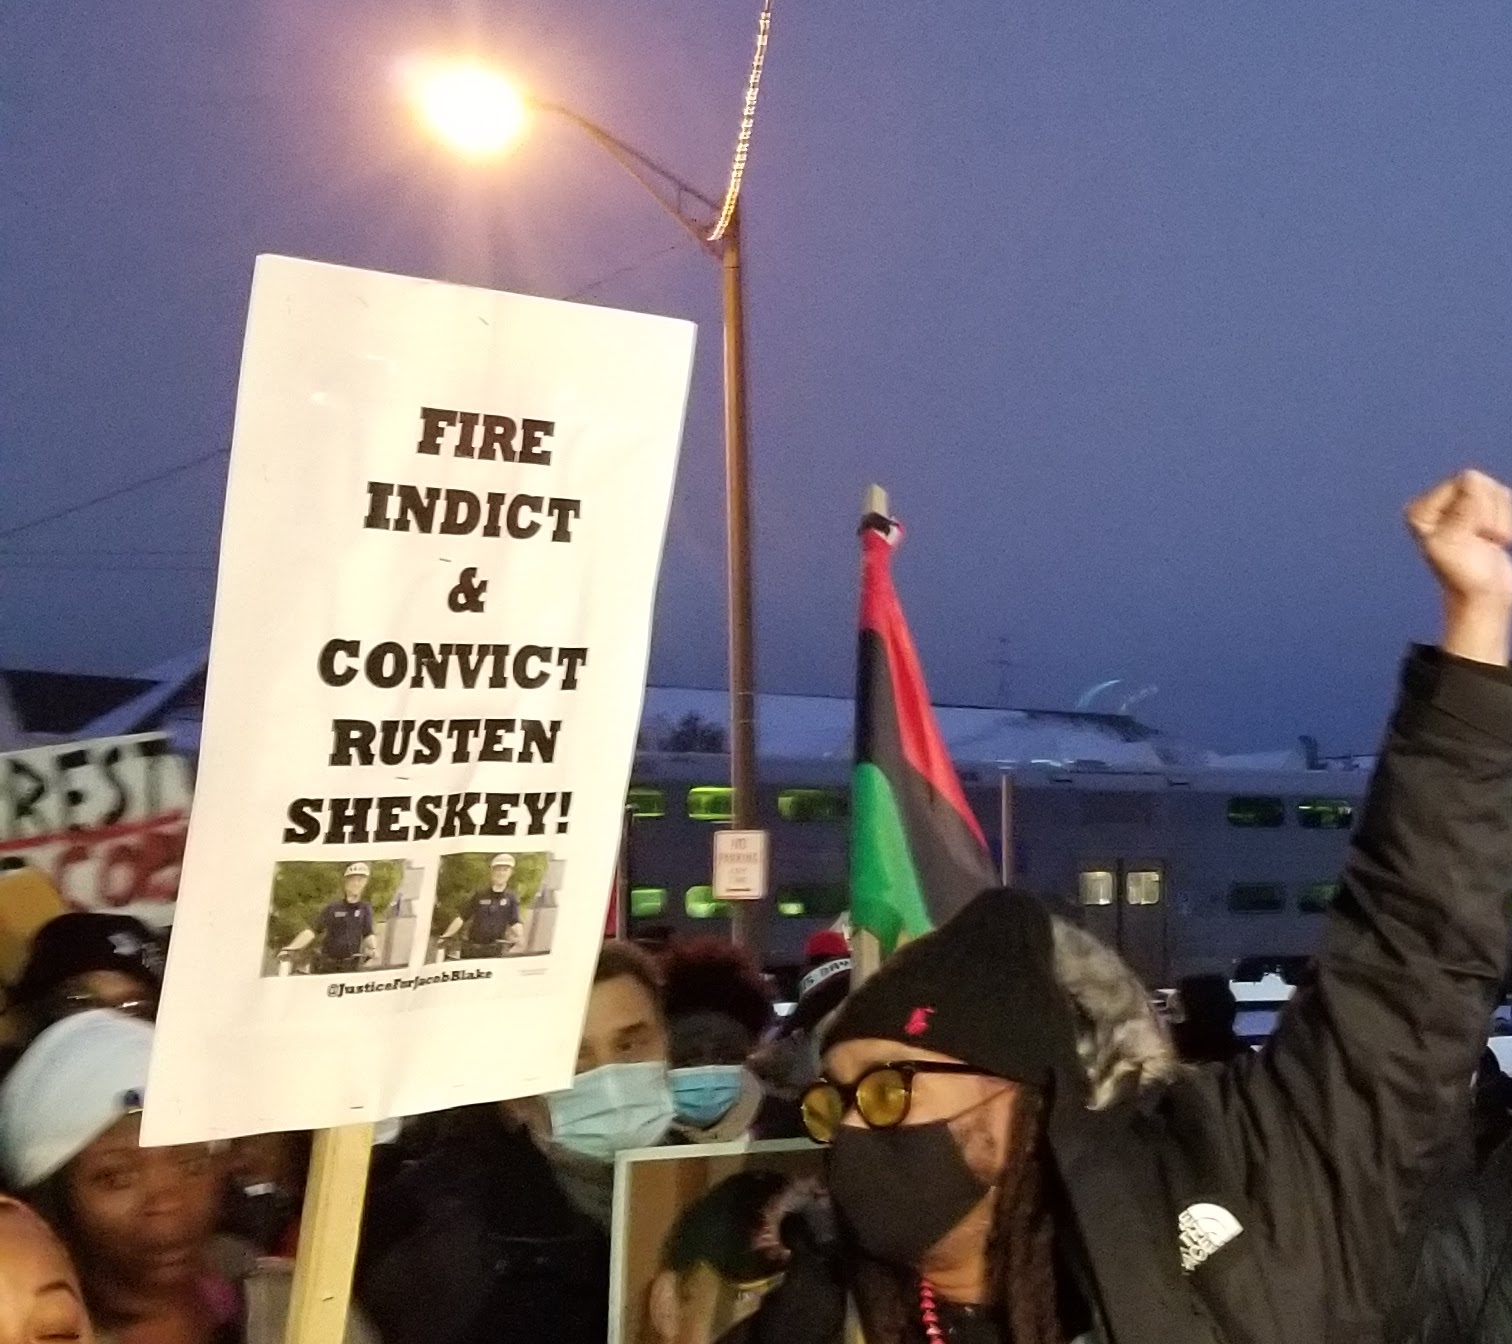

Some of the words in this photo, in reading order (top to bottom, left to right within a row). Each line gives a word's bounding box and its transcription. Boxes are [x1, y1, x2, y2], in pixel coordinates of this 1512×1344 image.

[416, 407, 555, 466] FIRE
[363, 481, 581, 543] INDICT
[448, 567, 488, 613] &
[317, 638, 589, 690] CONVICT
[328, 719, 562, 766] RUSTEN
[282, 791, 573, 844] SHESKEY!
